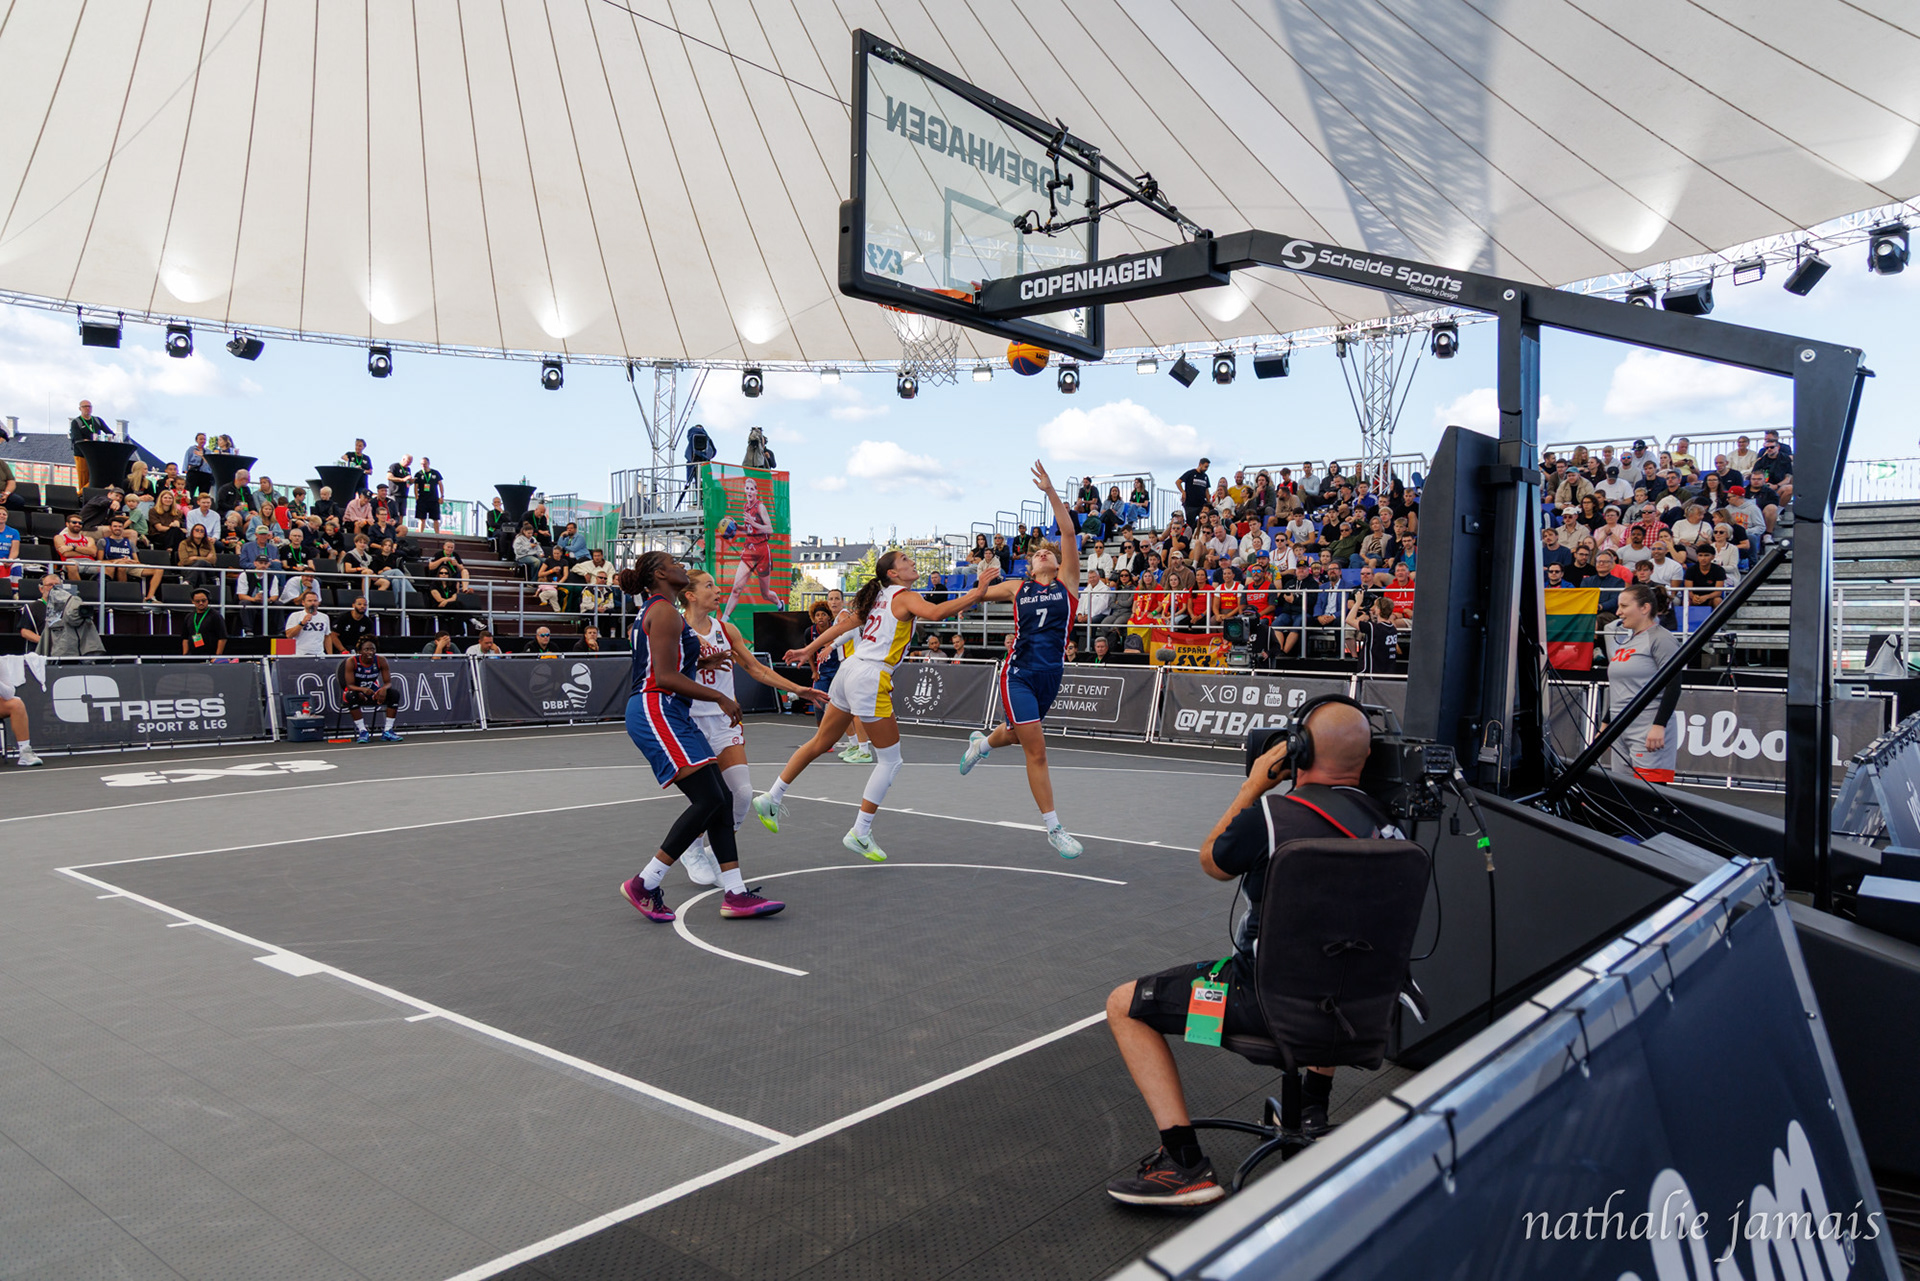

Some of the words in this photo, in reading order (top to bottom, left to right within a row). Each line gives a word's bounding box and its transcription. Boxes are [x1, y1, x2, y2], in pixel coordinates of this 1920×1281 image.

[1020, 256, 1162, 300] COPENHAGEN
[1318, 249, 1394, 277] Schelde
[1395, 267, 1462, 293] Sports
[1409, 284, 1432, 295] Superior
[1432, 289, 1440, 297] by
[1439, 290, 1459, 300] Design
[1020, 596, 1039, 605] GREAT
[1040, 592, 1063, 602] BRITAIN
[1247, 593, 1265, 601] ESP
[1036, 608, 1048, 628] 7
[863, 614, 882, 643] 22
[1177, 645, 1207, 654] ESPAÑA
[699, 669, 715, 685] 13
[296, 672, 455, 714] GOOAT
[904, 696, 915, 712] CITY
[919, 667, 943, 711] COPENHAGEN
[1058, 684, 1075, 693] ORT
[1077, 685, 1110, 696] EVENT
[1268, 684, 1280, 694] You
[542, 700, 569, 709] DBBF
[1266, 695, 1280, 705] Tube
[93, 697, 226, 722] TRESS
[137, 721, 183, 733] SPORT
[188, 720, 199, 731] &
[203, 719, 228, 730] LEG
[1674, 710, 1843, 767] ilso
